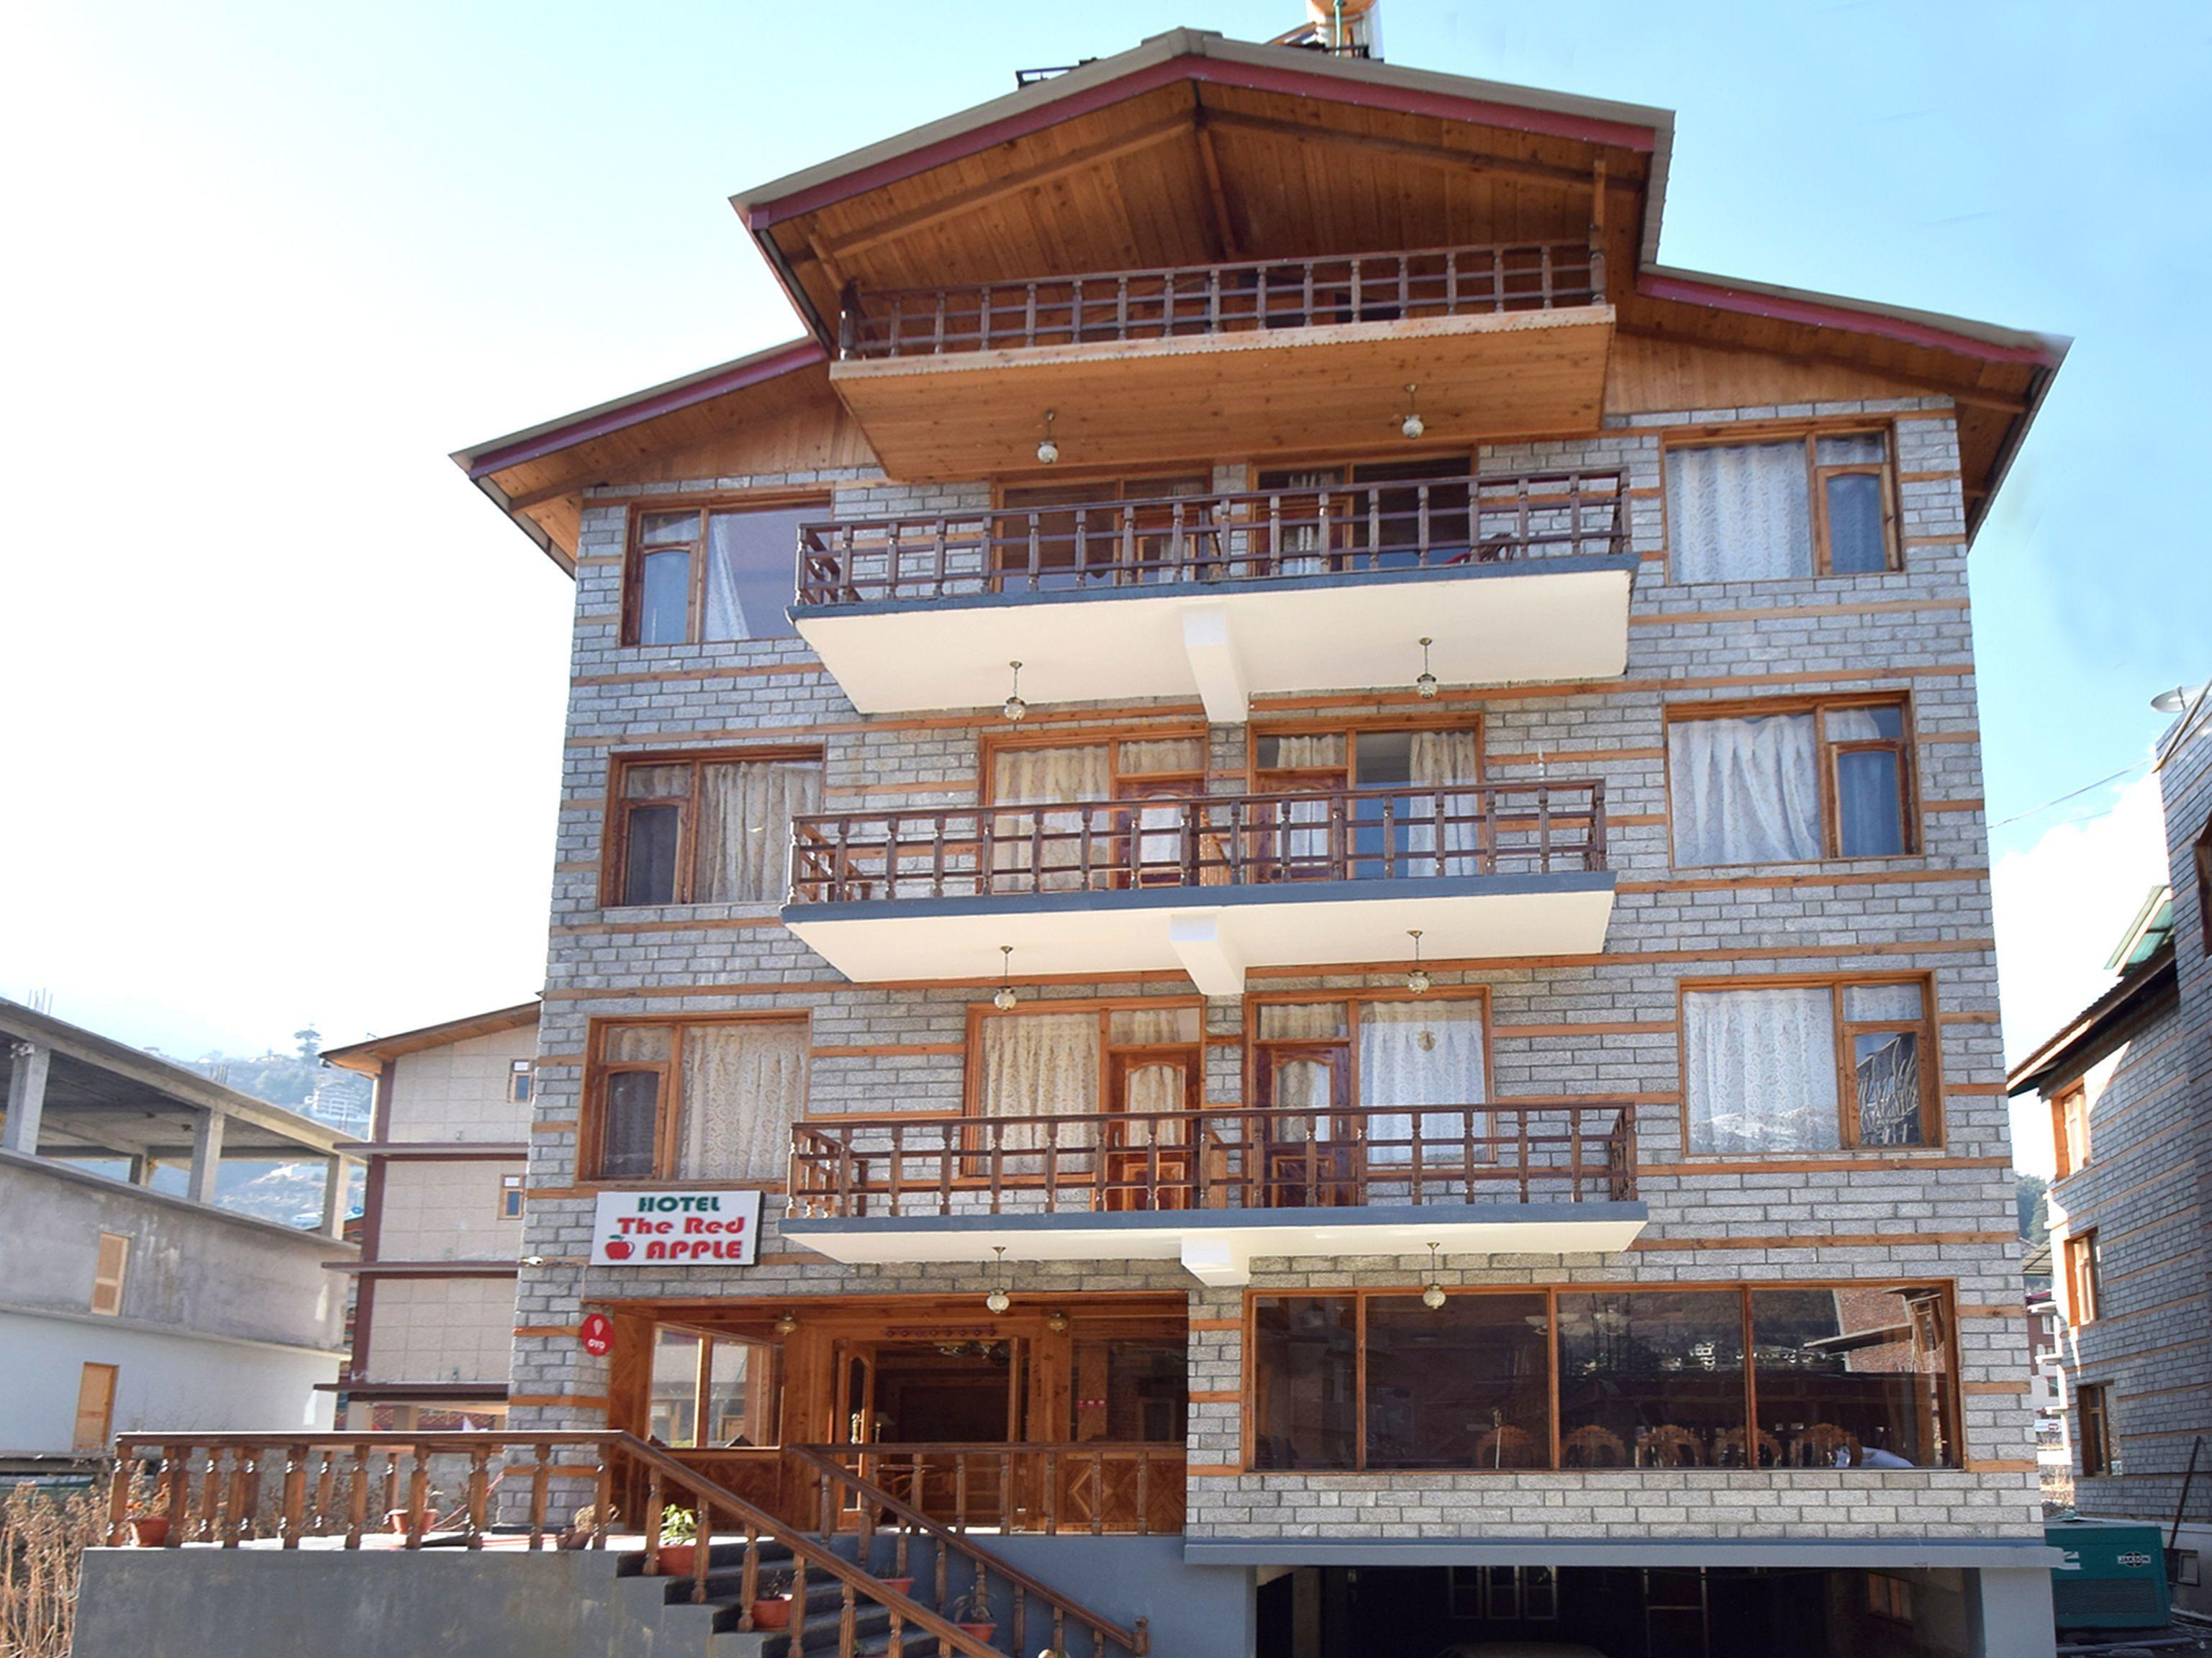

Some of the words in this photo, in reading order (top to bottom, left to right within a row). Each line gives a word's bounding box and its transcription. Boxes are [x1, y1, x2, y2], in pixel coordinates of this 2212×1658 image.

[638, 1197, 720, 1212] HOTEL
[617, 1217, 674, 1234] The
[684, 1217, 745, 1234] Red
[646, 1241, 742, 1259] APPLE
[588, 1338, 605, 1349] OYO
